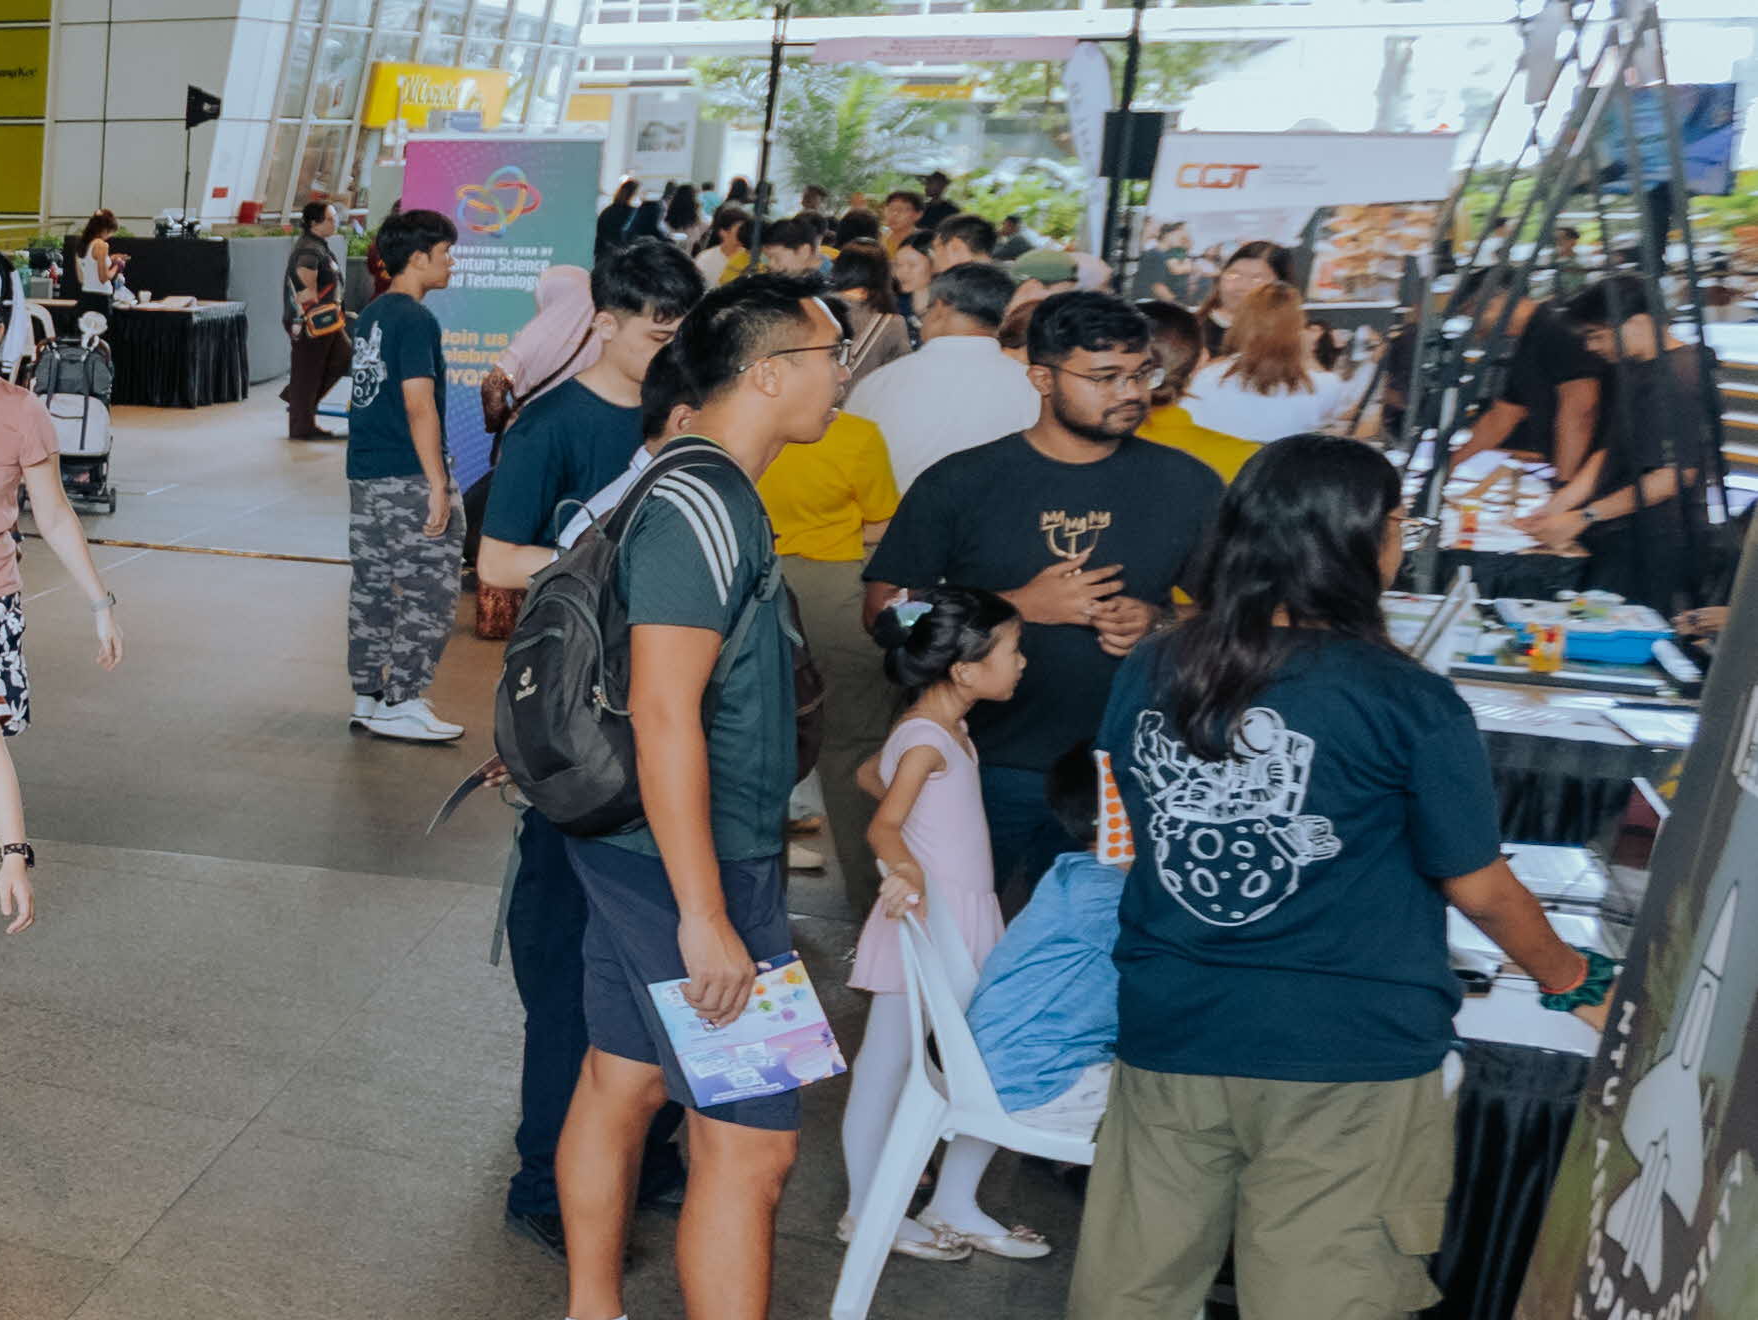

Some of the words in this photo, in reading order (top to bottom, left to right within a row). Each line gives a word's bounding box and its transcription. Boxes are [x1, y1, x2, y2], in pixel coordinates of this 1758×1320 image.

[451, 258, 495, 271] antum
[499, 257, 550, 272] Science
[467, 272, 539, 292] Technolog
